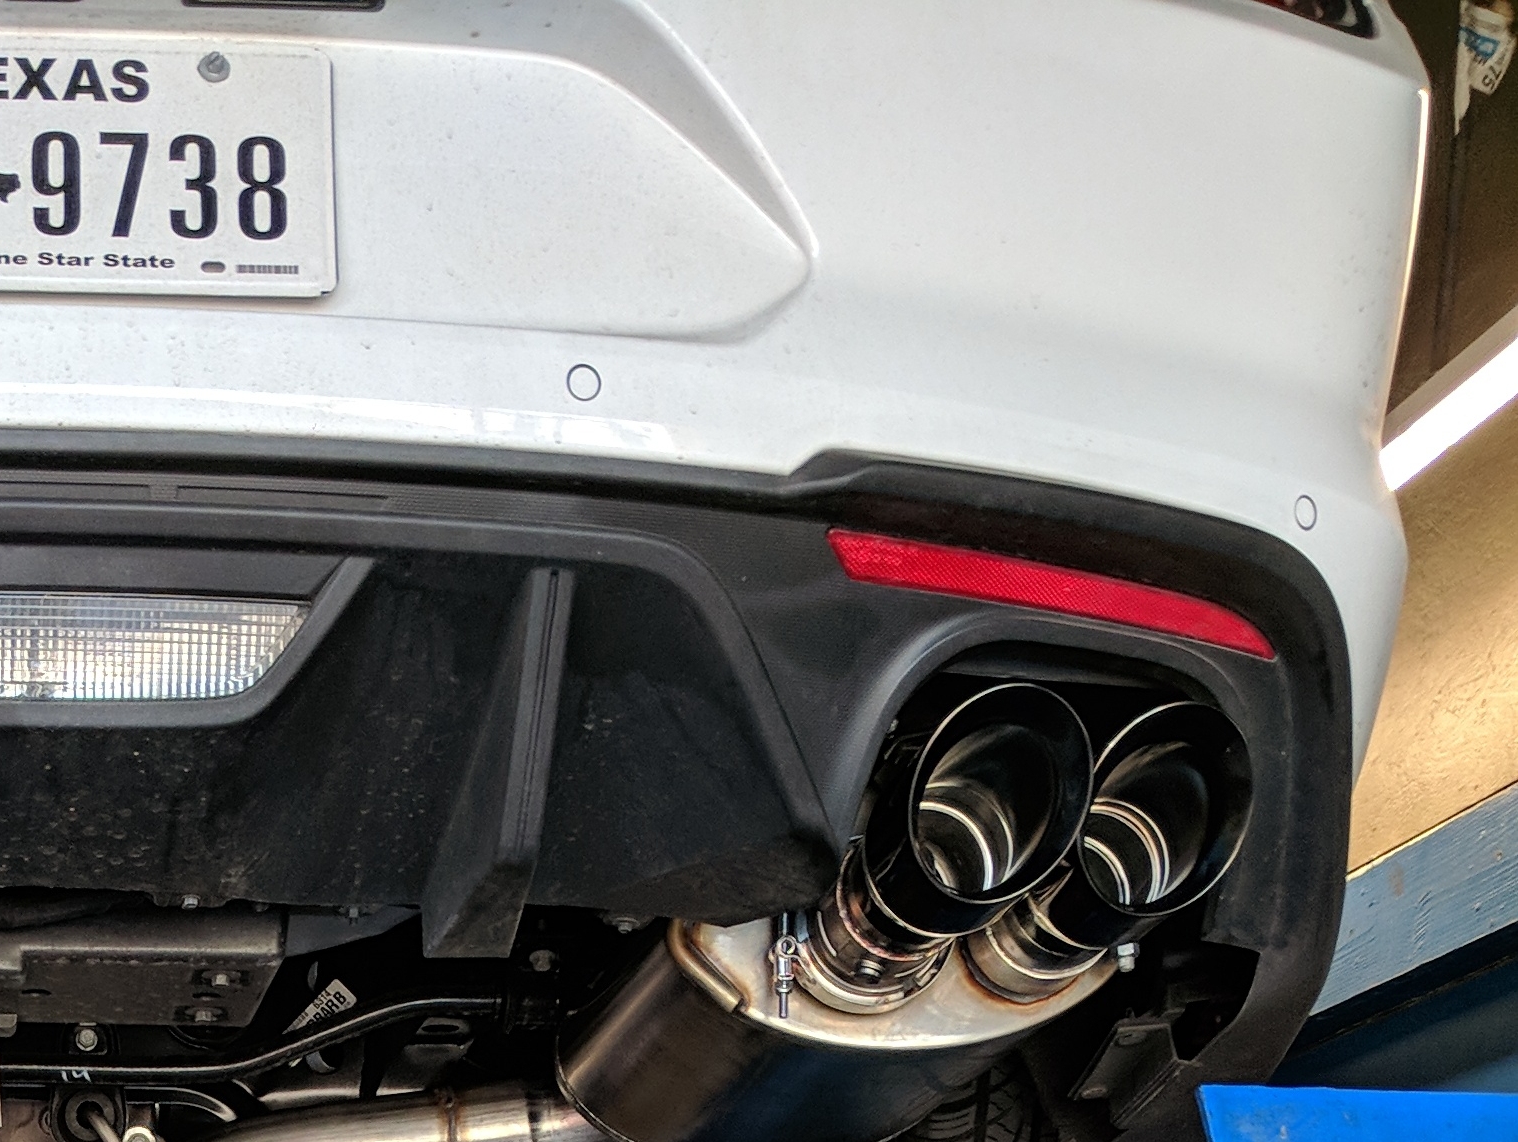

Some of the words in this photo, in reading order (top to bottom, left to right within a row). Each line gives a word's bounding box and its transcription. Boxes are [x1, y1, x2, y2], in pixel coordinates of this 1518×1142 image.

[31, 131, 288, 240] 9738
[37, 252, 95, 266] Star
[103, 254, 176, 269] State
